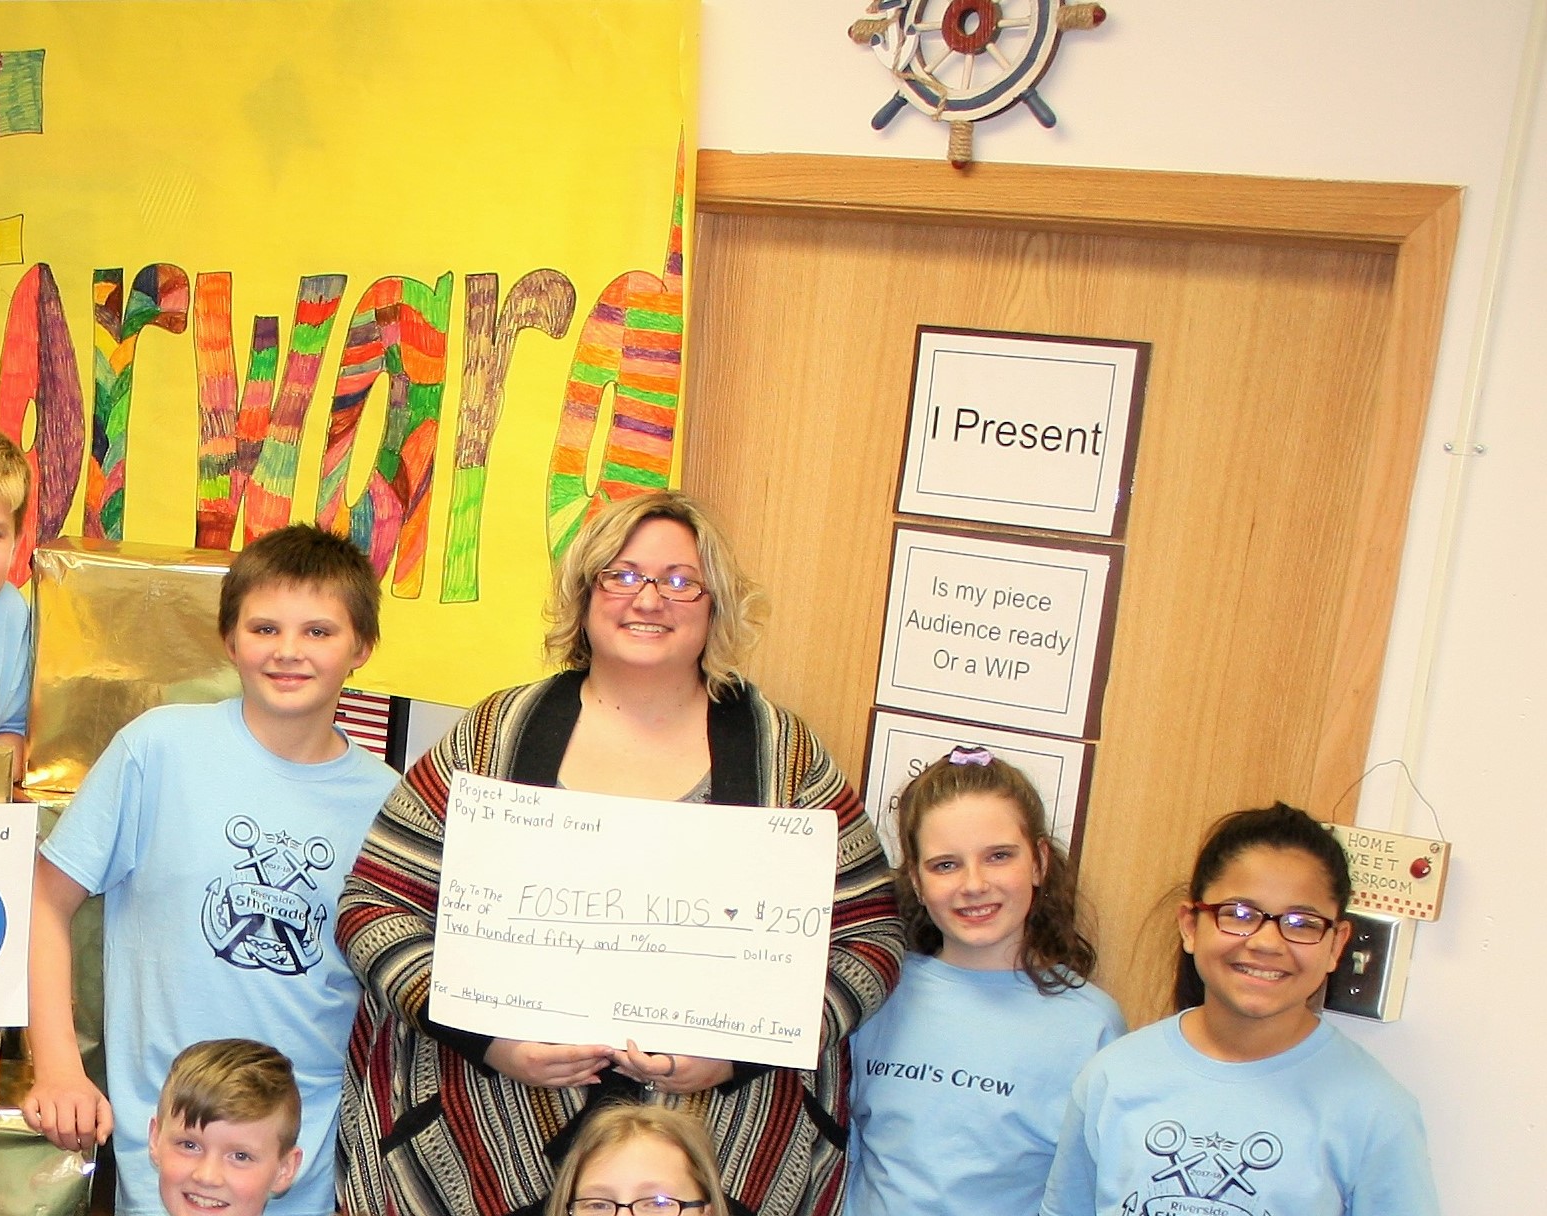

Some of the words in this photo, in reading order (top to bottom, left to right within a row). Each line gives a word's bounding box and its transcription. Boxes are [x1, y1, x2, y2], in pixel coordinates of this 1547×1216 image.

[930, 405, 941, 440] I
[953, 408, 1102, 456] Present
[932, 576, 949, 598] Is
[955, 583, 987, 607] my
[993, 587, 1052, 612] piece
[905, 609, 1001, 642] Audience
[1008, 627, 1071, 656] ready
[933, 649, 959, 673] Or
[964, 656, 977, 674] a
[985, 658, 1030, 682] WIP
[459, 777, 502, 801] Project
[510, 787, 541, 806] Jack
[455, 798, 476, 823] Pay
[482, 805, 495, 820] It
[504, 810, 554, 828] Forward
[563, 815, 602, 832] Grant
[768, 815, 814, 836] 4426
[1347, 832, 1396, 853] HOME
[1345, 851, 1400, 872] WEET
[250, 888, 296, 906] Riverside
[442, 896, 472, 912] Order
[449, 879, 466, 899] Pay
[483, 887, 503, 902] The
[234, 894, 260, 911] 5th
[262, 902, 306, 922] Grade
[518, 884, 624, 920] FOSTER
[647, 893, 710, 927] KIDS
[442, 913, 469, 934] Two
[476, 919, 536, 945] hundred
[544, 928, 585, 954] fifty
[594, 934, 620, 951] and
[743, 949, 792, 964] Dollars
[433, 980, 448, 993] For
[461, 987, 499, 1009] Helping
[505, 994, 543, 1010] Others
[684, 1009, 746, 1032] Foundation
[750, 1017, 765, 1034] of
[769, 1020, 802, 1038] Iowa
[866, 1058, 944, 1083] Verzal's
[951, 1068, 1015, 1097] Crew
[1170, 1201, 1229, 1216] Riverside
